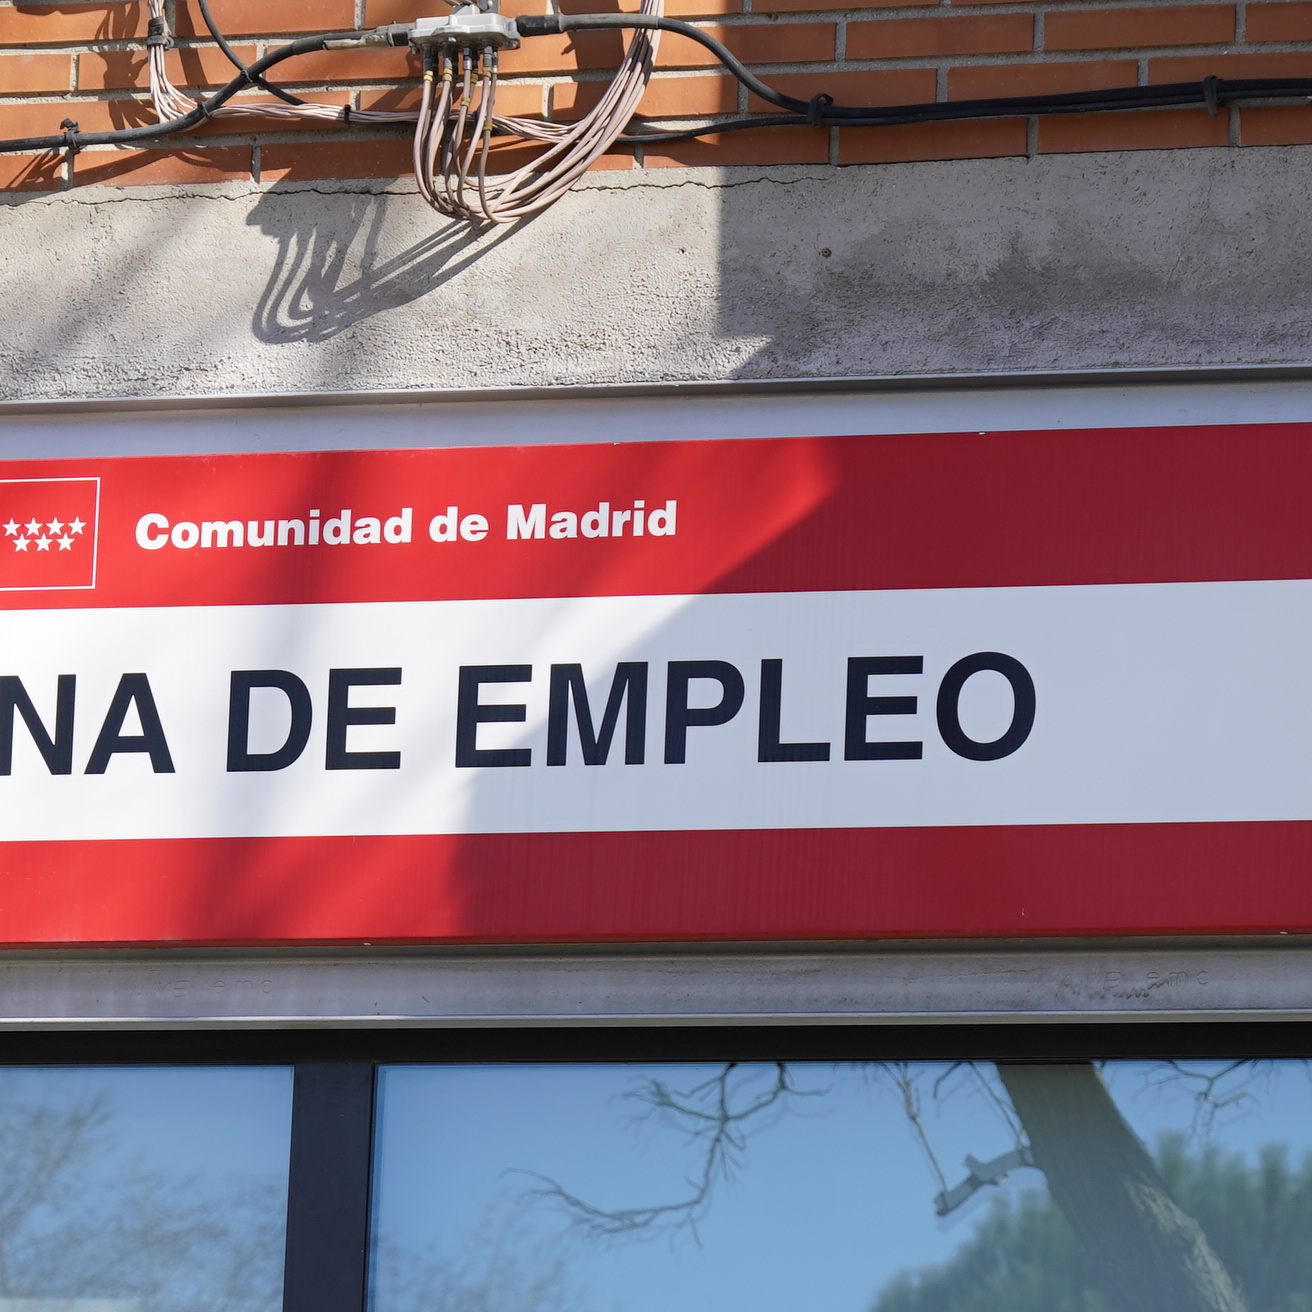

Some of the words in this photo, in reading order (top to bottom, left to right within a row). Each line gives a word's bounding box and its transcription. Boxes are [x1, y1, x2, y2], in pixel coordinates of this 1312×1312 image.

[135, 509, 412, 550] Comunidad
[429, 506, 488, 542] de
[506, 500, 677, 540] Madrid
[227, 667, 403, 772] DE
[454, 651, 1037, 768] EMPLEO
